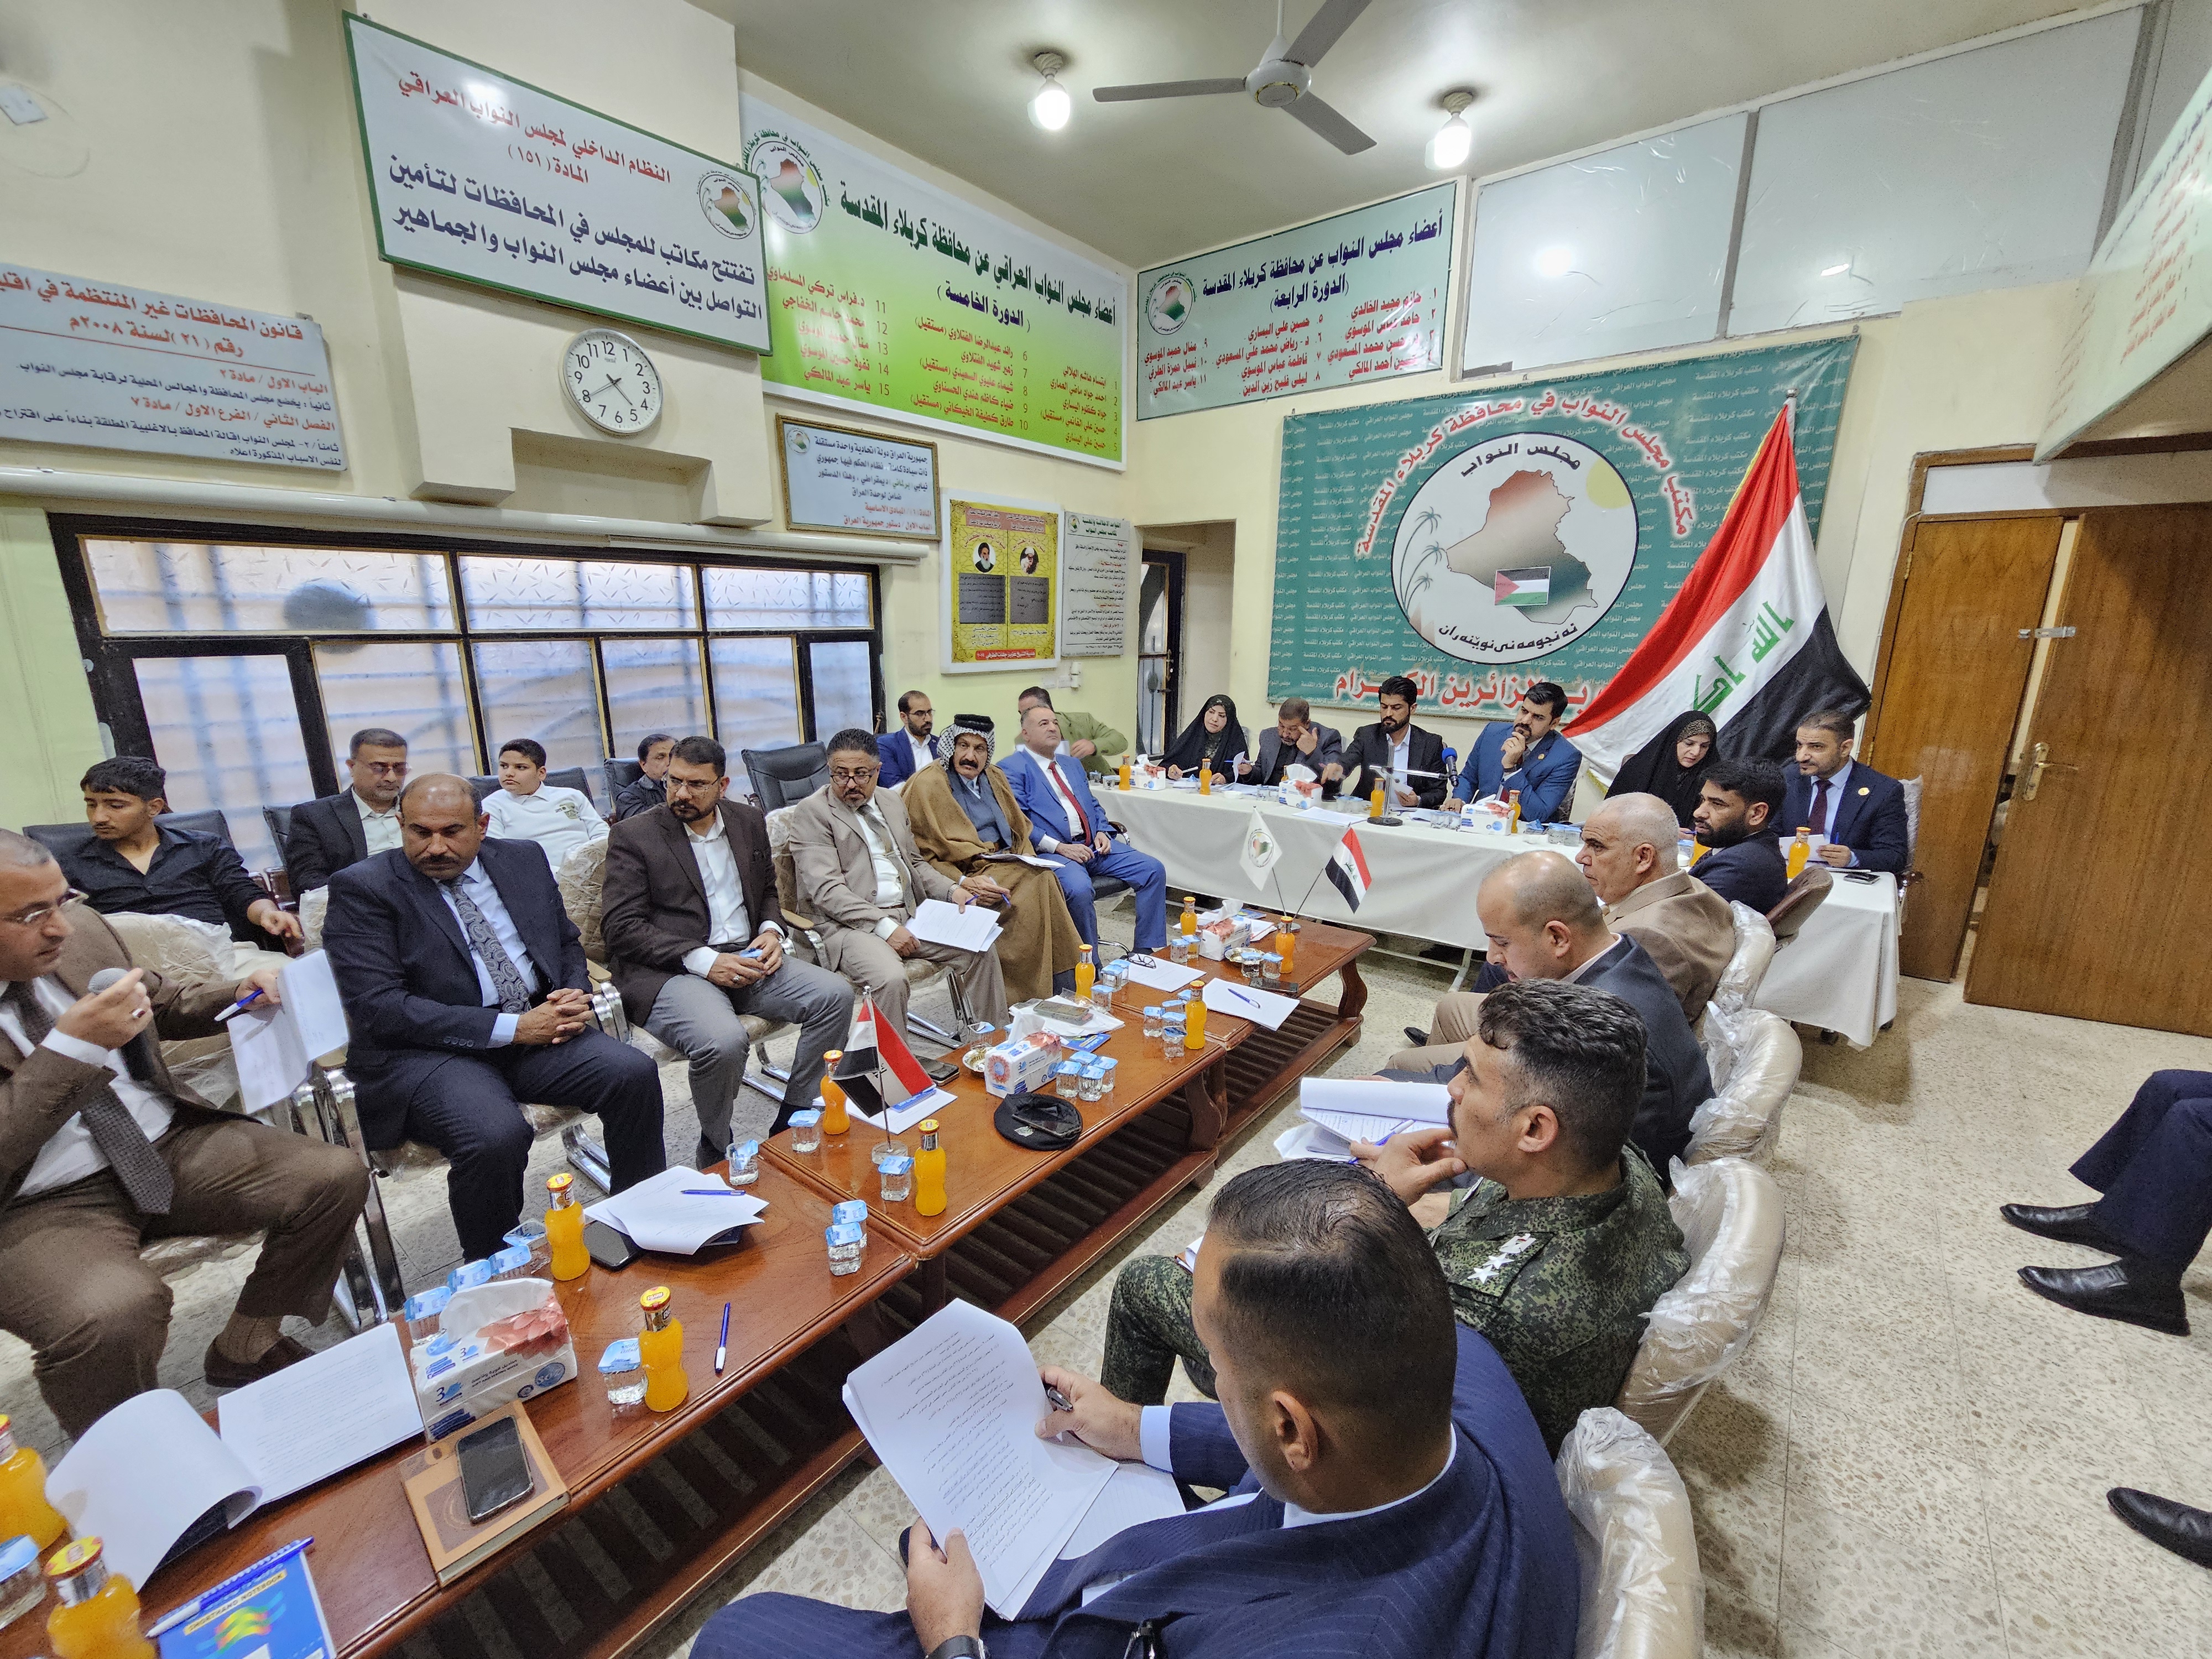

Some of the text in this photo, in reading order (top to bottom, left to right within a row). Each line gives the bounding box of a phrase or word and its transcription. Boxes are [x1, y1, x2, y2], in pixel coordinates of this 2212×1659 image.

[398, 70, 671, 184] النظام الداخلي لمجلس النواب العراقي
[552, 156, 588, 184] المادة
[840, 180, 888, 232] المقدسة
[389, 154, 755, 285] تفتتح مكاتب للمجلس في المحافظات لتأمين
[893, 207, 928, 251] كربلاء
[931, 221, 971, 267] محافظة
[1202, 207, 1443, 296] أعضاء مجلس النواب عن محافظة كربلاء المقدسة
[392, 206, 762, 320] التواصل بين أعضاء مجلس النواب والجماهير
[974, 249, 990, 276] عن
[993, 254, 1031, 291] العراقي
[37, 278, 59, 303] في
[60, 281, 137, 310] المنتظمة
[807, 280, 834, 299] تركي
[1034, 272, 1064, 305] النواب
[141, 300, 171, 320] غير
[875, 300, 885, 314] 11
[1067, 289, 1092, 319] مجلس
[1094, 296, 1115, 327] أعضاء
[174, 304, 255, 331] المحافظات
[1290, 317, 1311, 333] حسين
[259, 322, 304, 341] قانون
[1248, 322, 1274, 345] اليساري
[1275, 320, 1288, 339] علي
[213, 337, 244, 358] رقم
[587, 343, 598, 358] 11
[601, 341, 615, 356] 12
[623, 348, 628, 362] 1
[576, 354, 590, 369] 10
[1267, 357, 1286, 374] عباس
[1287, 352, 1308, 368] فاطمة
[58, 368, 89, 379] مجلس
[90, 369, 128, 385] لرقابة
[228, 369, 255, 383] مادة
[635, 363, 644, 376] 2
[1022, 367, 1027, 379] 7
[1241, 360, 1266, 382] الموسوي
[128, 374, 163, 388] المحلية
[267, 376, 295, 390] الاول
[574, 371, 583, 384] 9
[804, 365, 890, 396] 15 ياسر عبد المالكي
[164, 382, 208, 396] والمجالس
[208, 385, 248, 400] المحافظة
[298, 382, 328, 395] الباب
[643, 381, 650, 394] 3
[1243, 379, 1260, 398] الدين
[142, 397, 172, 410] مادة
[249, 394, 275, 404] مجلس
[276, 398, 301, 409] يخضع
[582, 389, 591, 403] 8
[185, 403, 216, 418] الاول
[598, 404, 606, 417] 7
[640, 398, 649, 410] 4
[1023, 403, 1028, 414] 9
[43, 413, 64, 423] على
[218, 408, 251, 421] الفرع
[263, 413, 299, 429] الثاني
[615, 411, 623, 424] 6
[630, 409, 638, 421] 5
[93, 416, 129, 429] المطلقة
[130, 420, 178, 437] بالاغلبية
[301, 419, 335, 431] الفصل
[999, 414, 1015, 432] طارق
[1019, 419, 1029, 431] 10
[179, 426, 213, 438] المحافظ
[242, 435, 270, 445] النواب
[271, 439, 296, 449] لمجلس
[813, 435, 836, 448] مستقلة
[836, 440, 854, 453] واحدة
[853, 442, 877, 455] اتحادية
[889, 450, 906, 461] العراق
[229, 447, 342, 466] لنفس الاسباب المذكورة اعلاه
[906, 451, 928, 465] جمهورية
[1460, 442, 1581, 477] مجلس النواب
[1356, 391, 1694, 555] مكتب مجلس النواب في محافظة كربلاء المقدسة
[1743, 601, 1795, 664] الله
[189, 1572, 285, 1631] SHORTHAND NOTEBOOK
